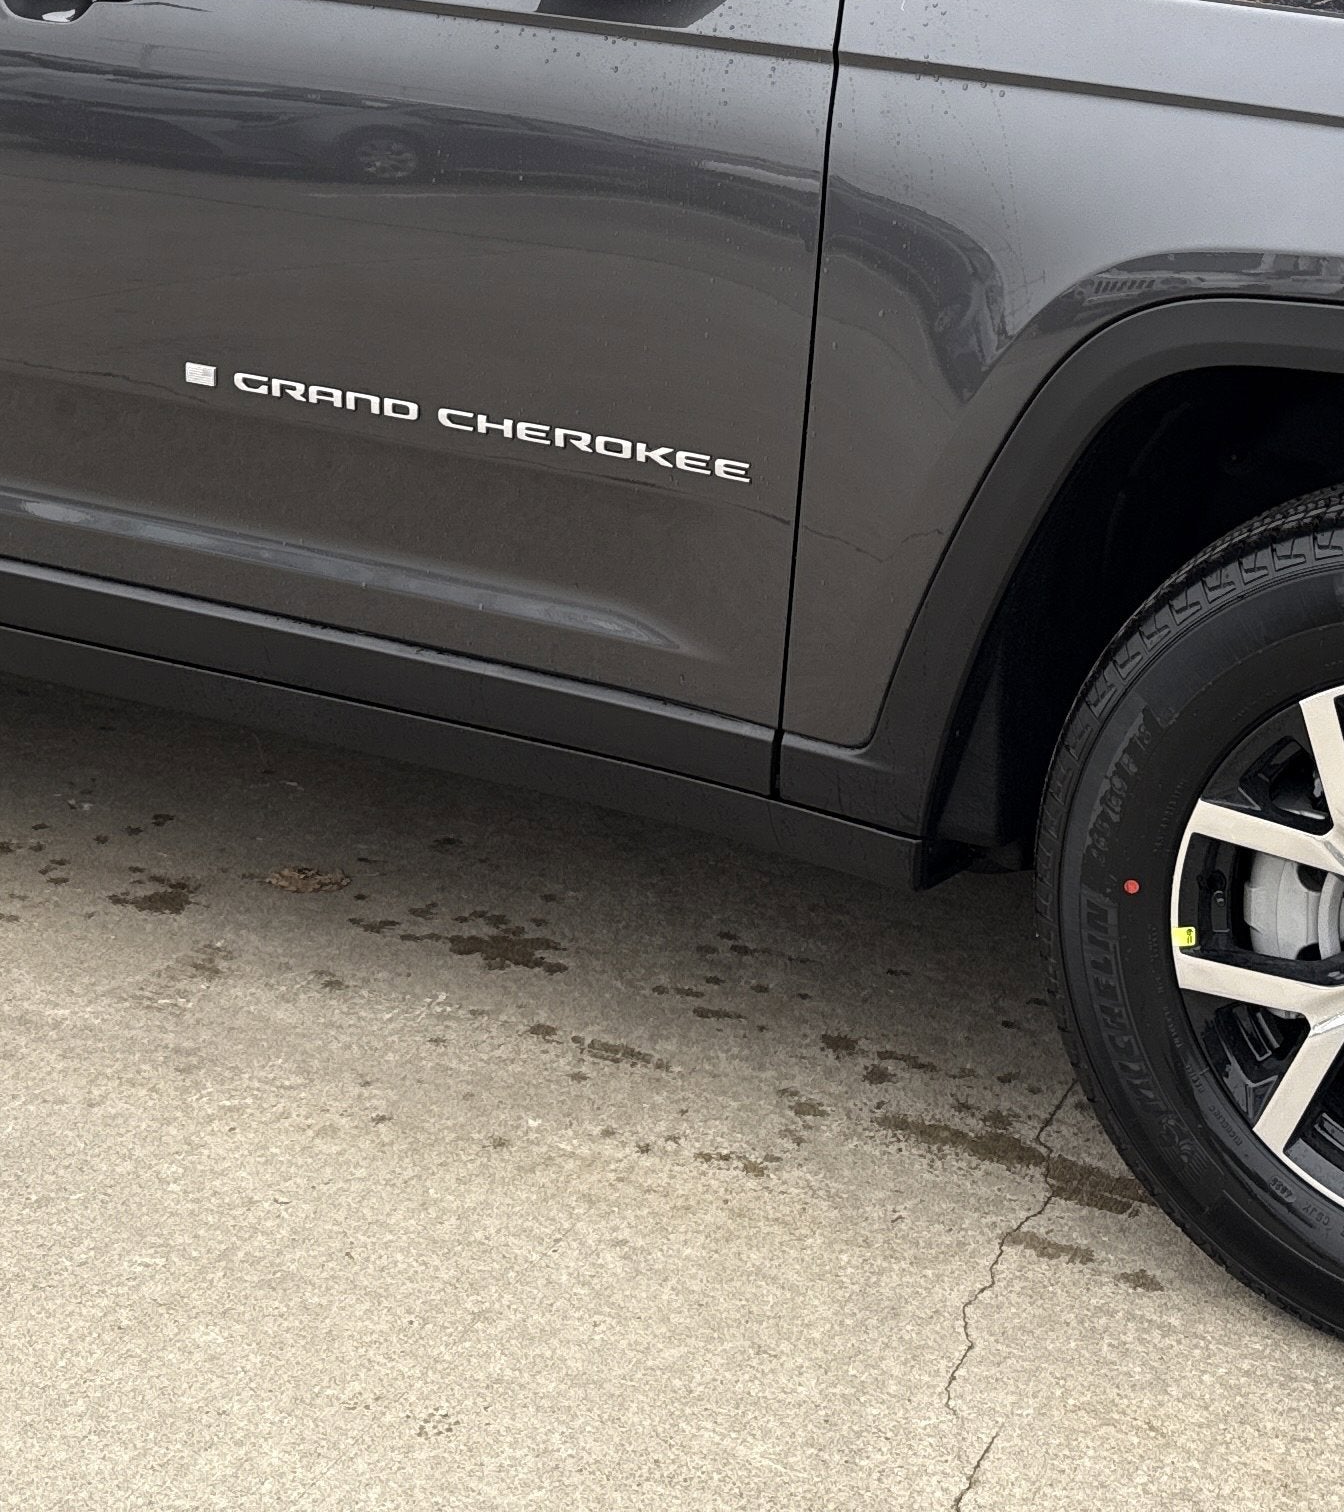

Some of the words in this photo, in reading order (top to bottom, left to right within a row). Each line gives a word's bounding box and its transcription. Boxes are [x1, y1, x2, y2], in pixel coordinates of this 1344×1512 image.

[233, 370, 420, 422] GRAND
[436, 406, 753, 484] CHEROKEE
[1084, 896, 1164, 1114] MICHELIN
